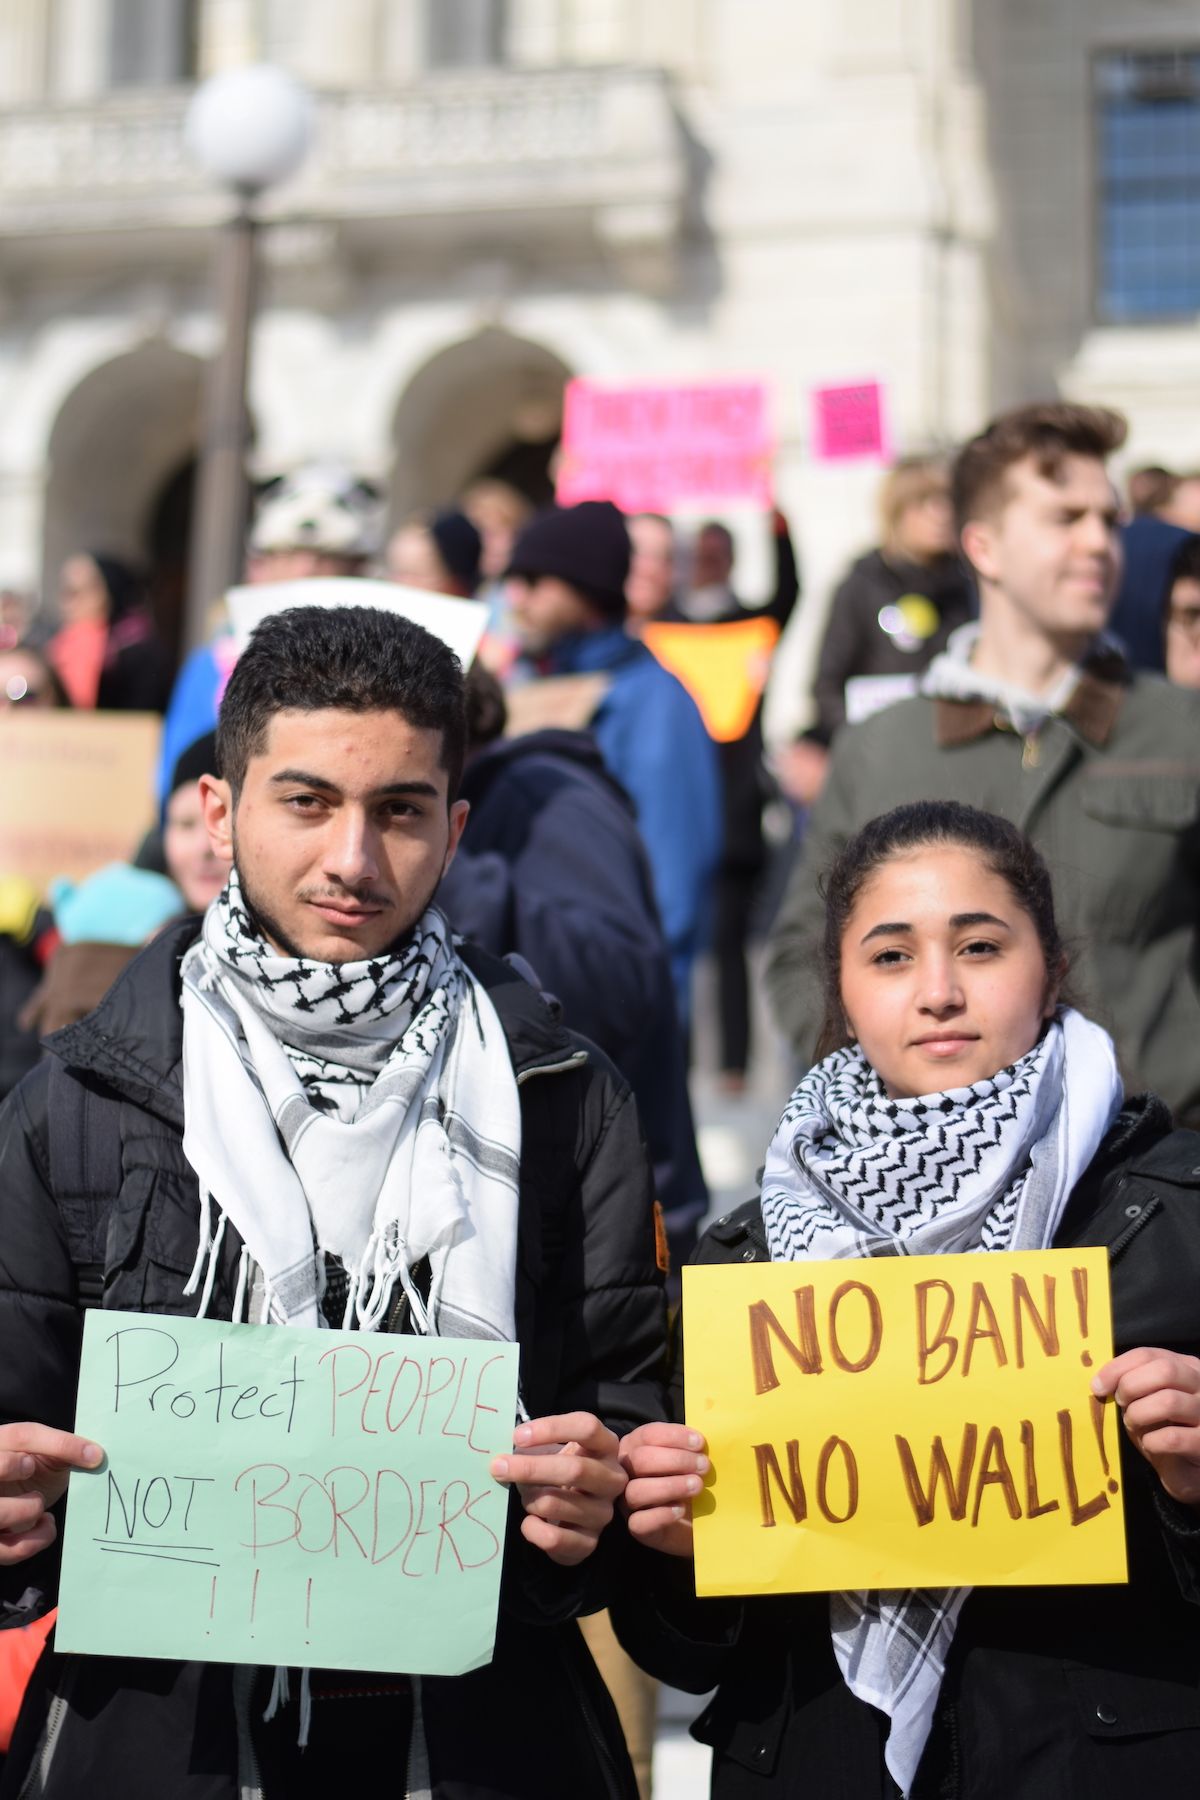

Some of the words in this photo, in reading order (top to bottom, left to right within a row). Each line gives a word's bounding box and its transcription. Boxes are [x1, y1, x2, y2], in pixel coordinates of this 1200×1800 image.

[106, 1327, 305, 1433] Protect
[318, 1344, 505, 1453] PEOPLE
[748, 1279, 883, 1395] NO
[914, 1266, 1093, 1385] BAN!
[104, 1470, 215, 1538] NOT
[235, 1463, 500, 1577] BORDERS
[750, 1434, 859, 1528] NO
[894, 1394, 1119, 1527] WALL!
